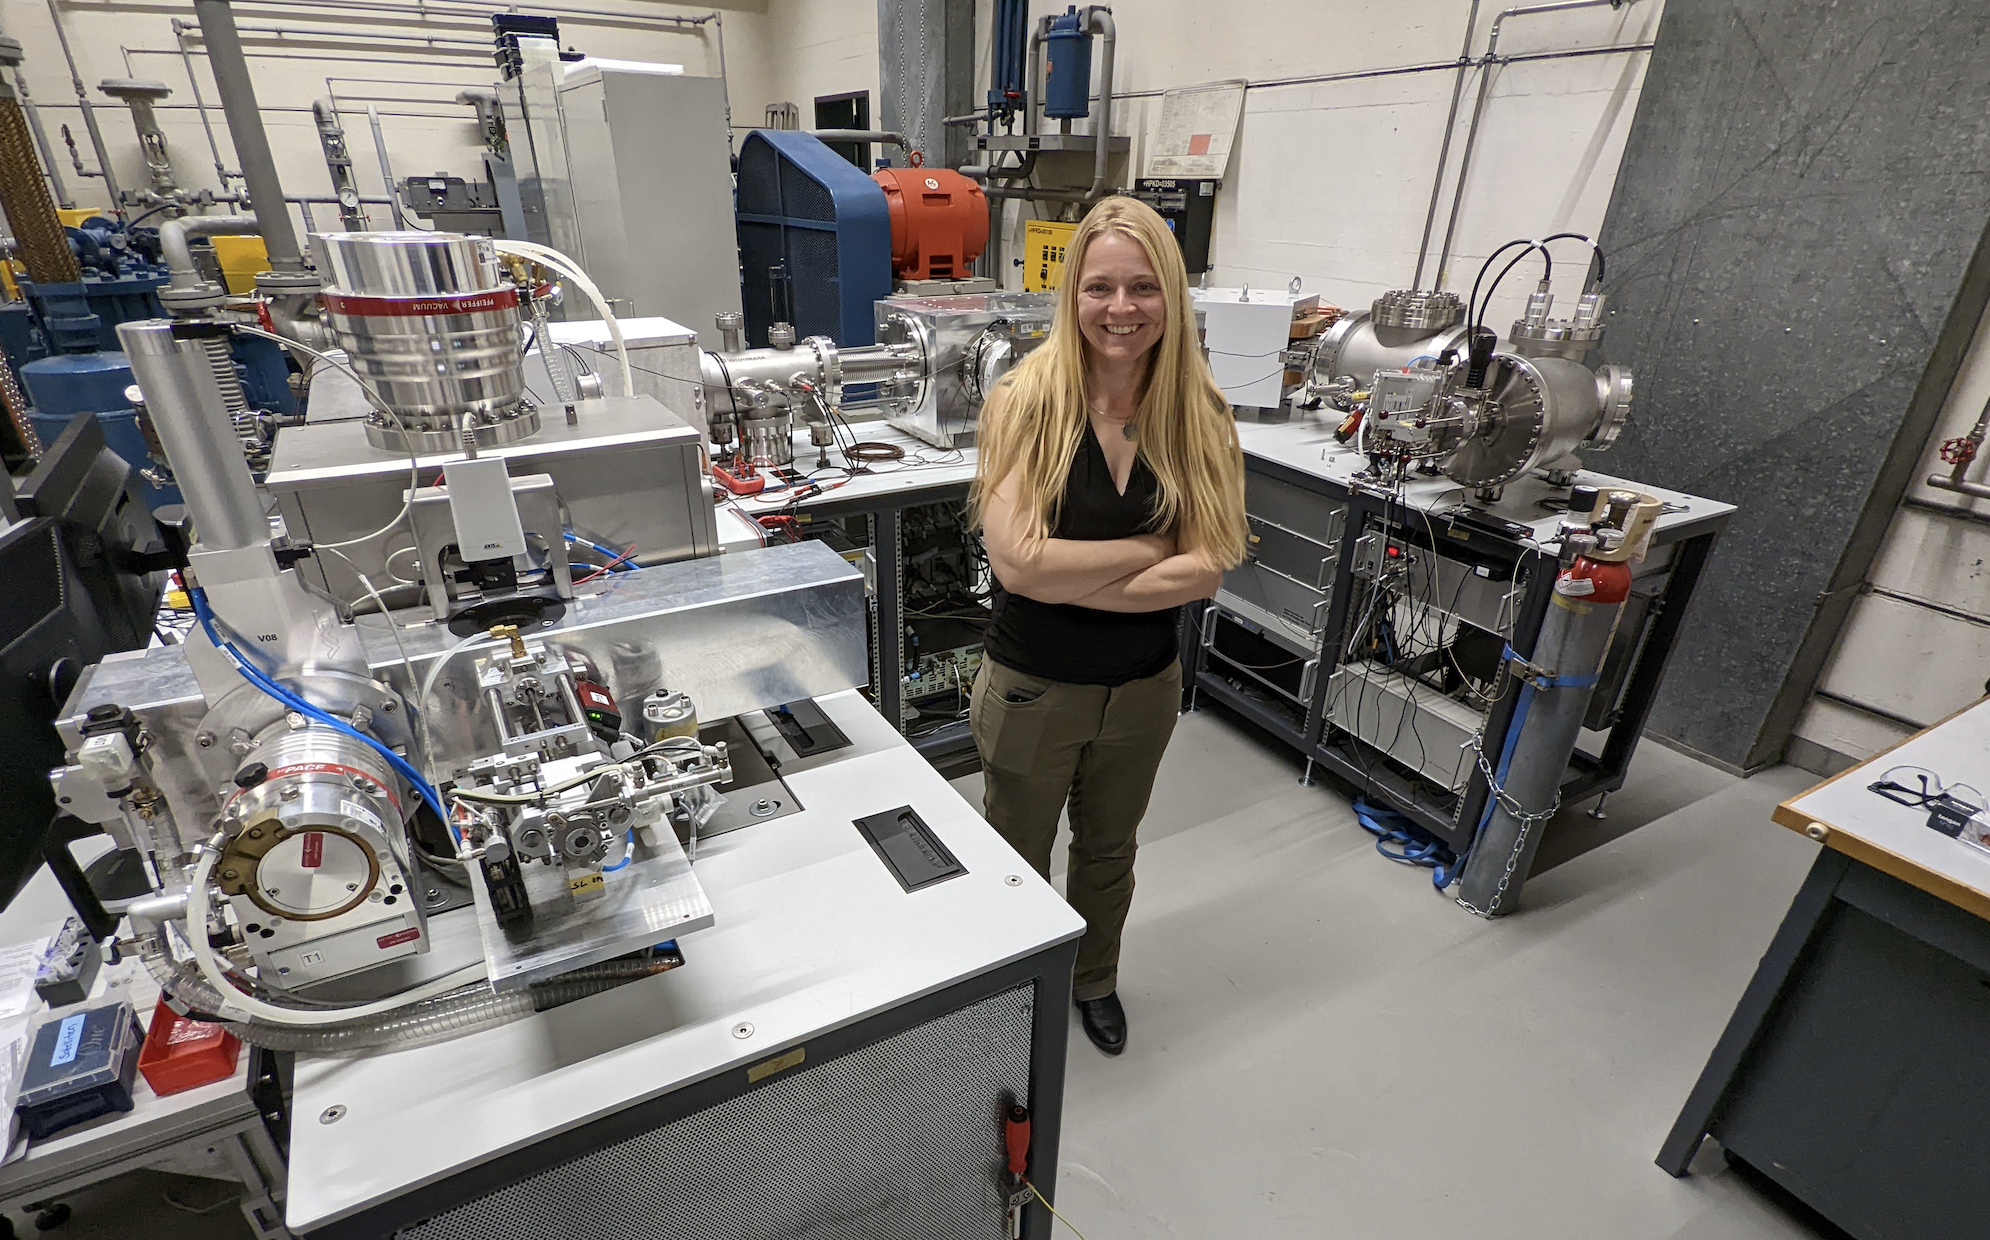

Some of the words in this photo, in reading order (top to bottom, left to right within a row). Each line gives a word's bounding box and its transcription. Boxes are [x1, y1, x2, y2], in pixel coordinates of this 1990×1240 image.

[412, 302, 449, 311] VACUUM
[461, 298, 494, 308] PFEIFFER
[257, 633, 278, 642] V08
[303, 952, 321, 963] T1
